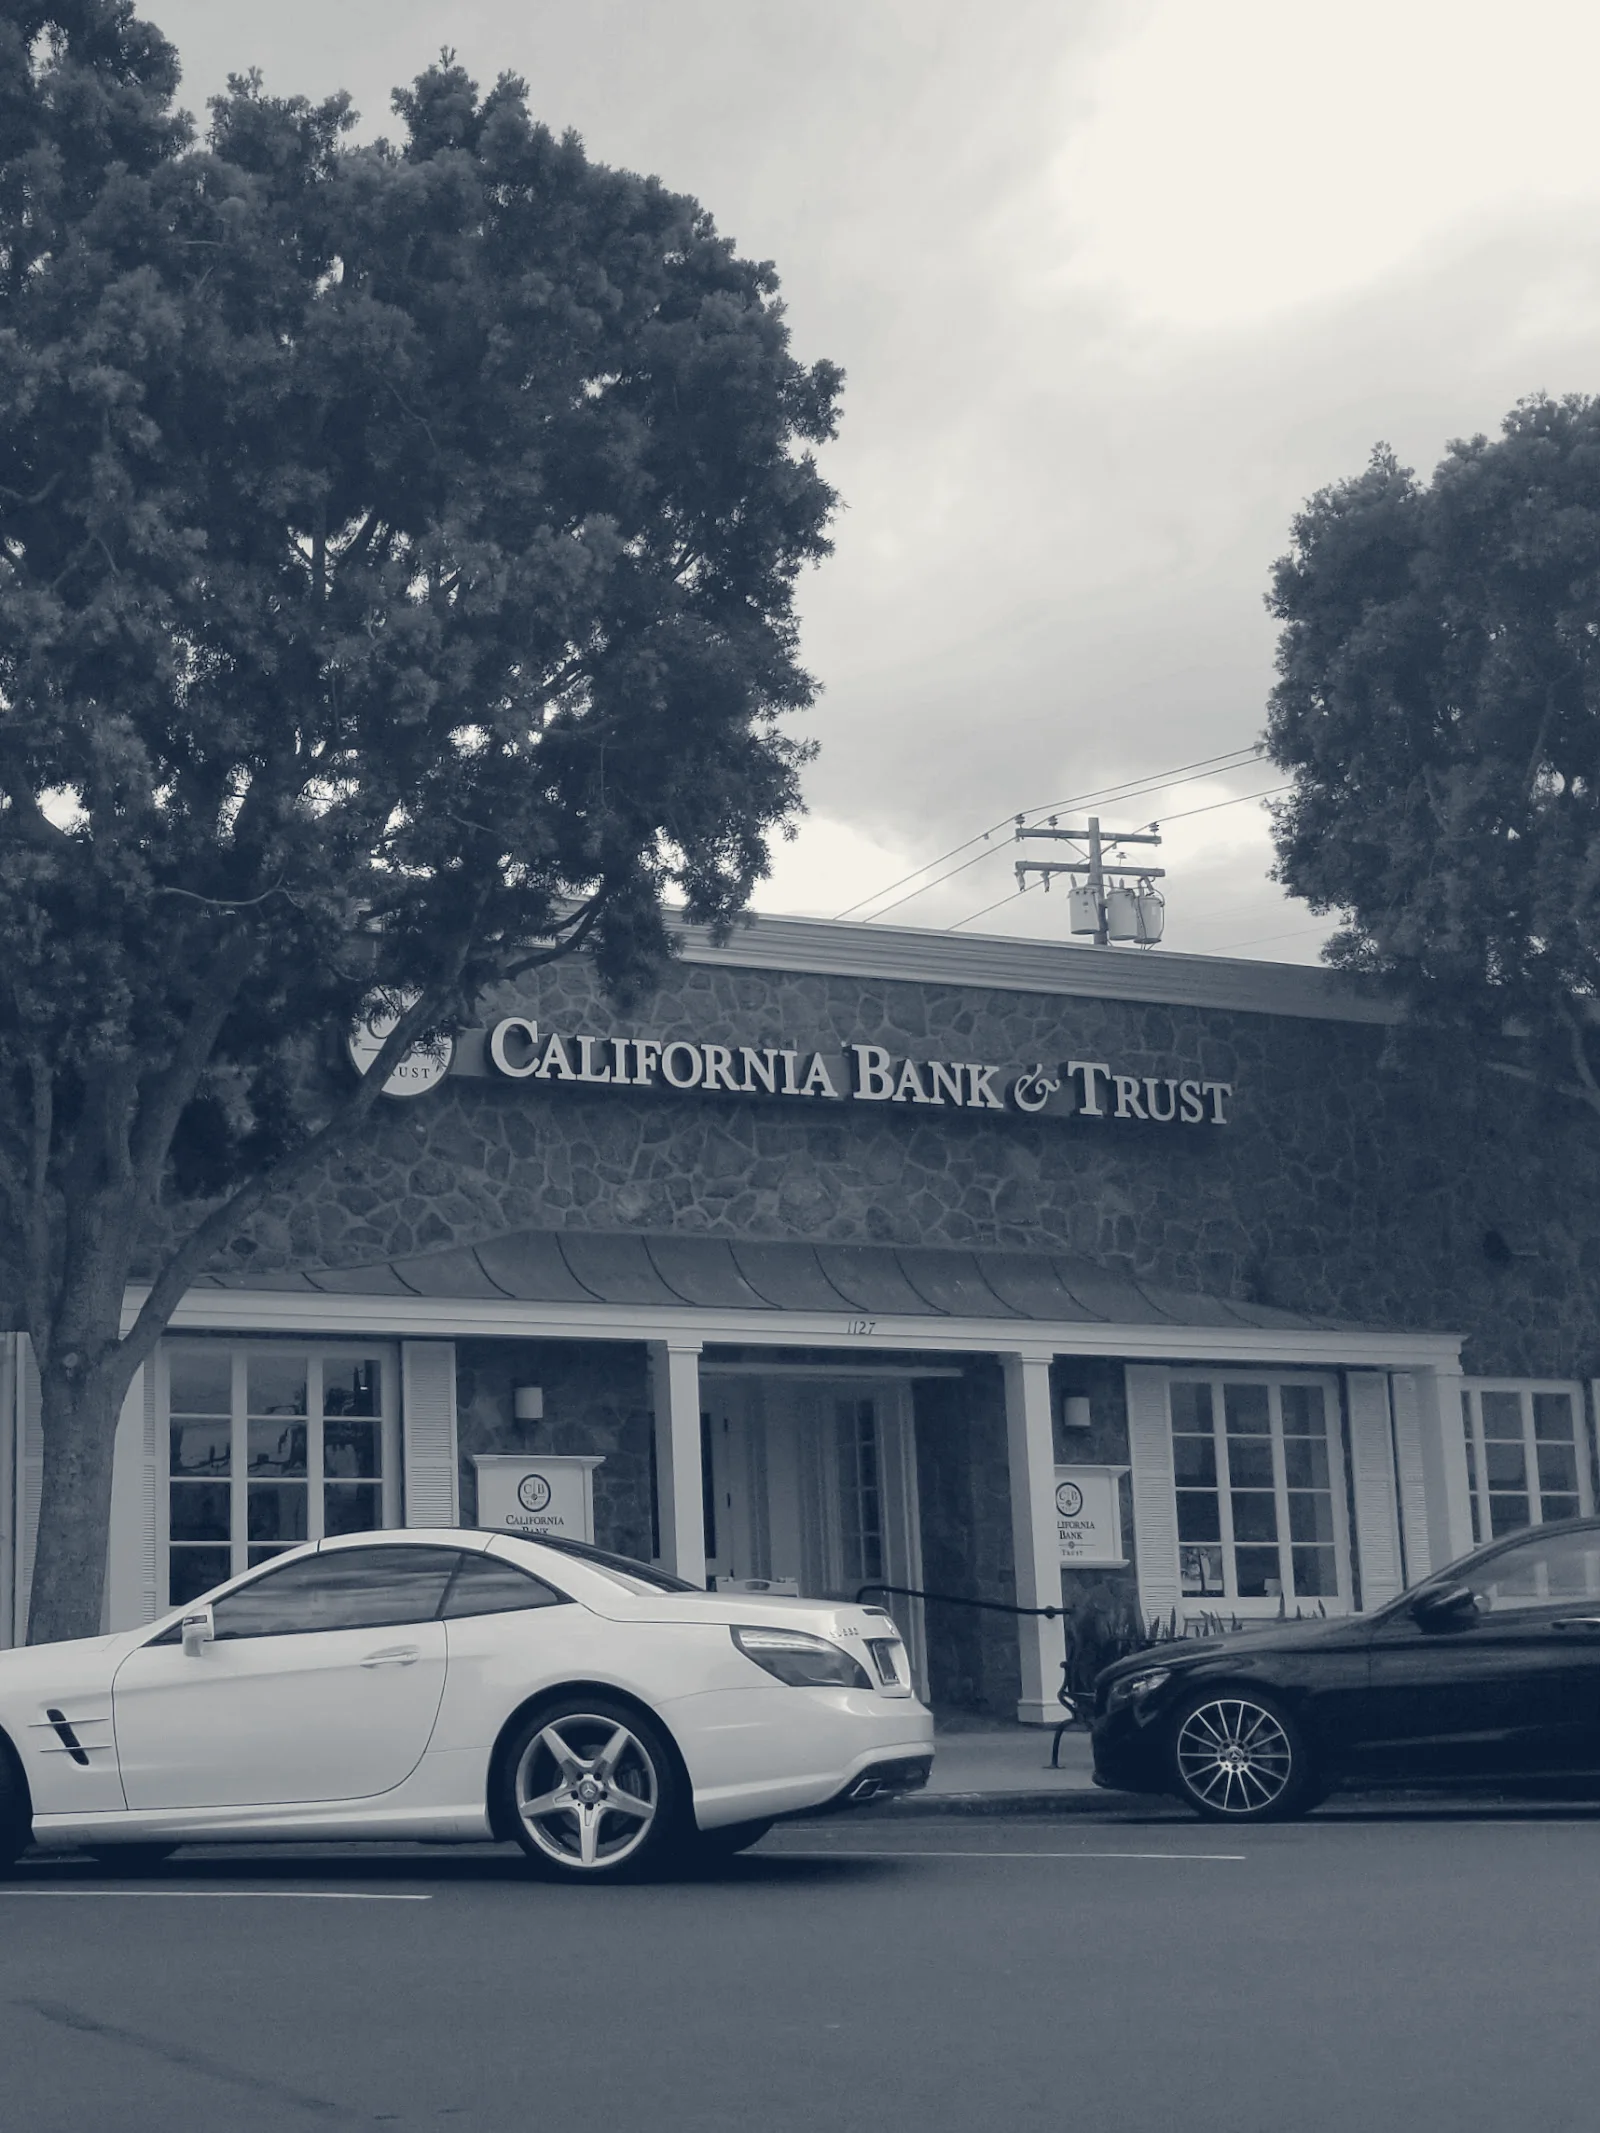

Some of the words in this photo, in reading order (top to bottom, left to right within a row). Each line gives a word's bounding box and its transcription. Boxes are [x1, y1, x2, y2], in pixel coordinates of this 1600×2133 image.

[392, 1066, 430, 1079] UST
[490, 1016, 838, 1097] CALIFORNIA
[852, 1044, 1004, 1109] BANK
[1014, 1064, 1060, 1113] &
[1067, 1060, 1232, 1125] TRUST
[847, 1321, 876, 1335] 1127
[505, 1514, 564, 1525] CALIFORNIA
[1057, 1520, 1095, 1529] LIFORNIA
[1060, 1530, 1083, 1540] BANK
